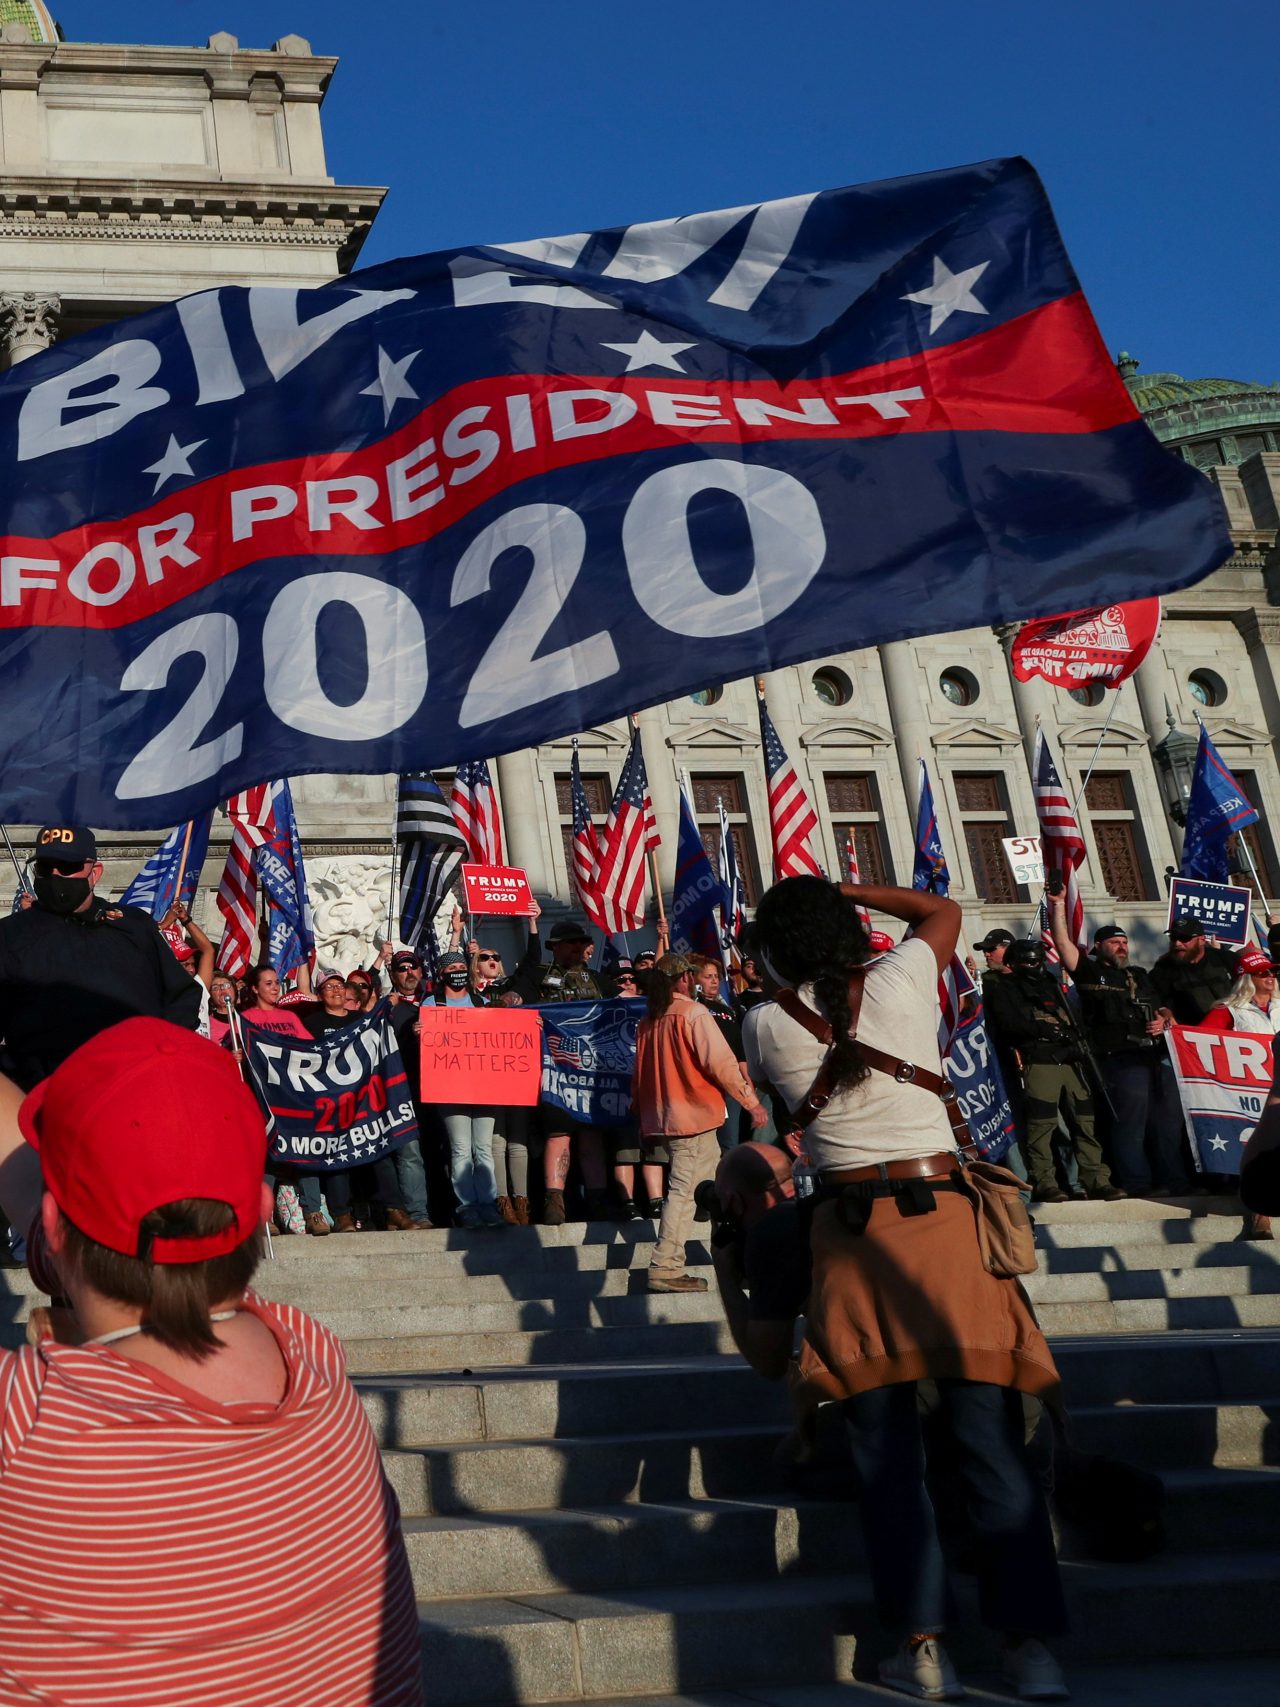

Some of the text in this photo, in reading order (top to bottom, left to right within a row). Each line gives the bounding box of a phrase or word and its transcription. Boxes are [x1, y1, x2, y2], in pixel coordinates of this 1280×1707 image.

[0, 386, 925, 607] FOR PRESIDENT
[114, 458, 827, 800] 2020
[41, 829, 74, 845] CPD
[467, 876, 526, 888] TRUMP
[485, 893, 517, 902] 2020
[1175, 894, 1246, 914] TRUMP
[1181, 907, 1238, 922] PENCE
[430, 1009, 467, 1024] THE
[422, 1031, 534, 1049] CONSTITUTION
[433, 1053, 531, 1073] MATTERS
[1238, 1095, 1261, 1113] NO
[291, 1133, 348, 1155] MORE
